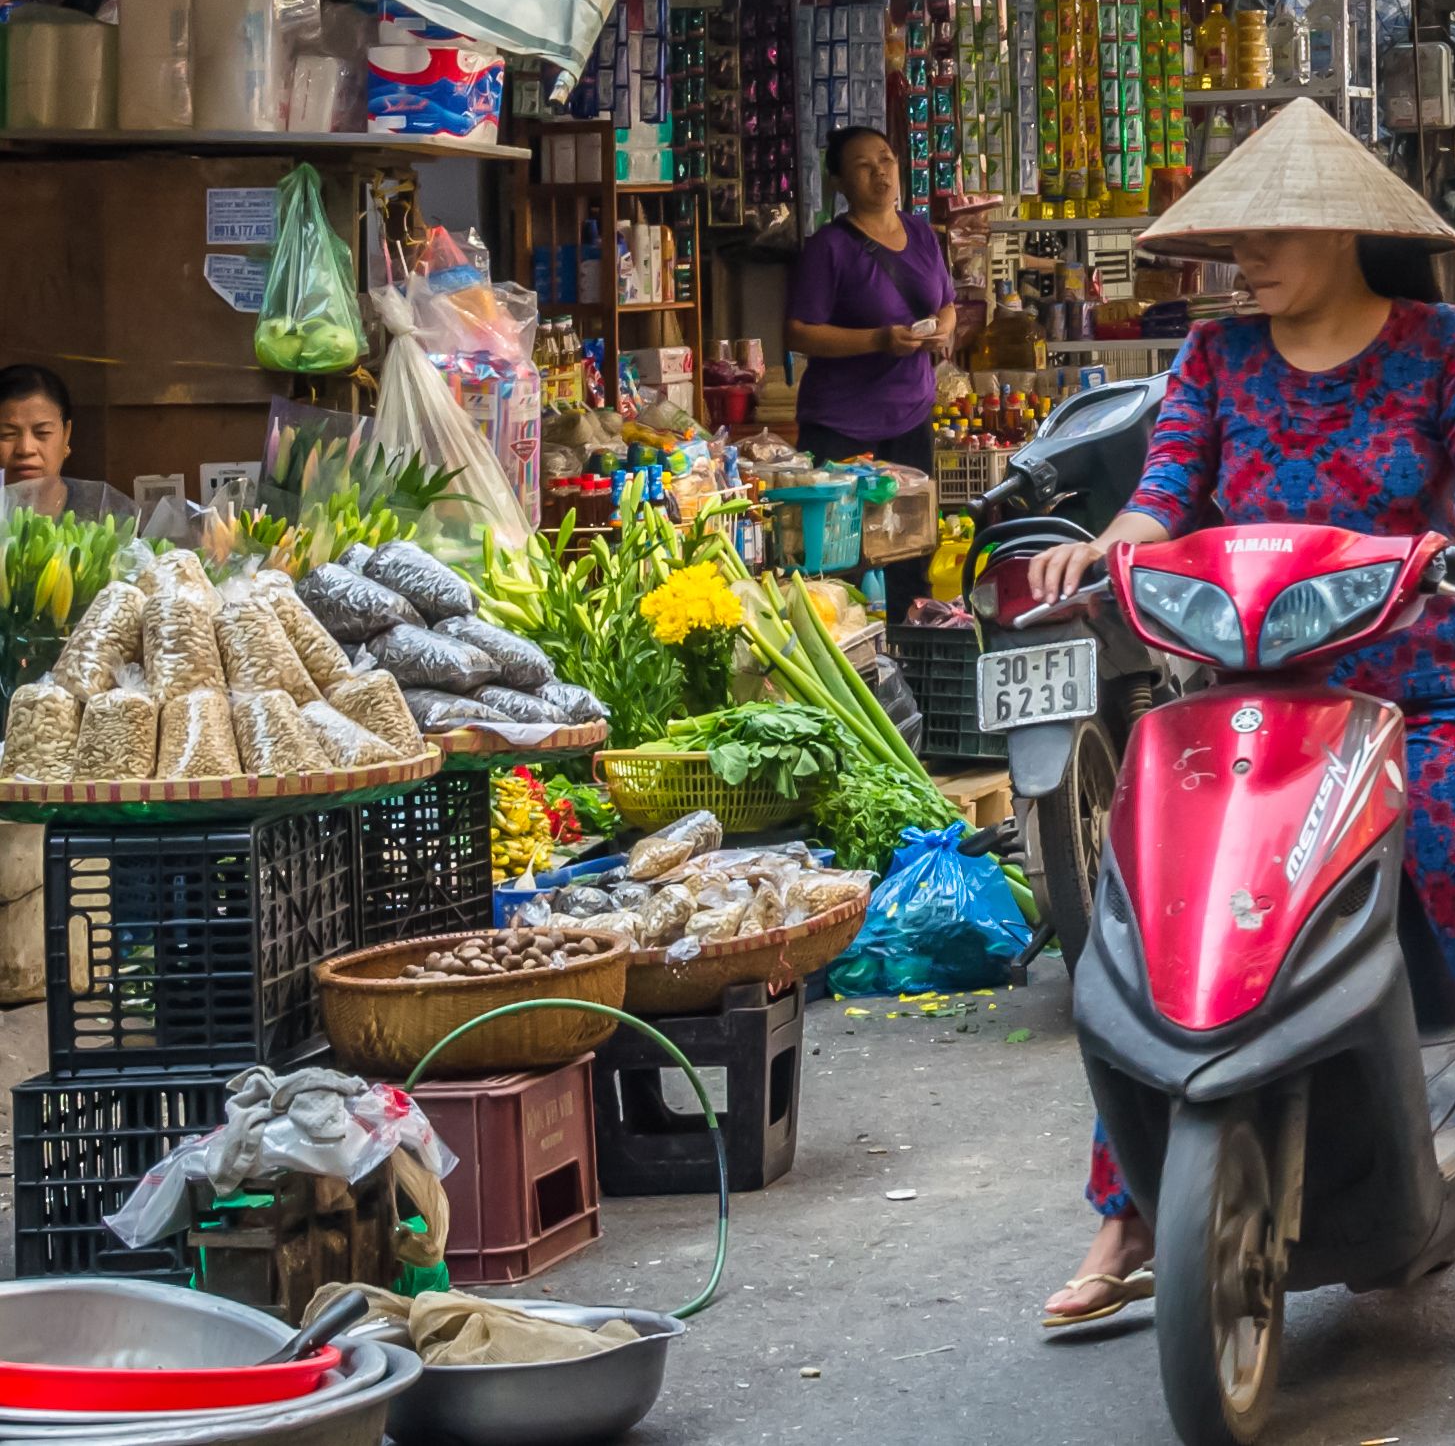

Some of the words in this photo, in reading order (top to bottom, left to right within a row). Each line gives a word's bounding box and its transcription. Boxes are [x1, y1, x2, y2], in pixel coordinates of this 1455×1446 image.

[1224, 538, 1293, 554] YAMAHA
[996, 648, 1077, 687] 30-F1
[997, 681, 1077, 721] 6239
